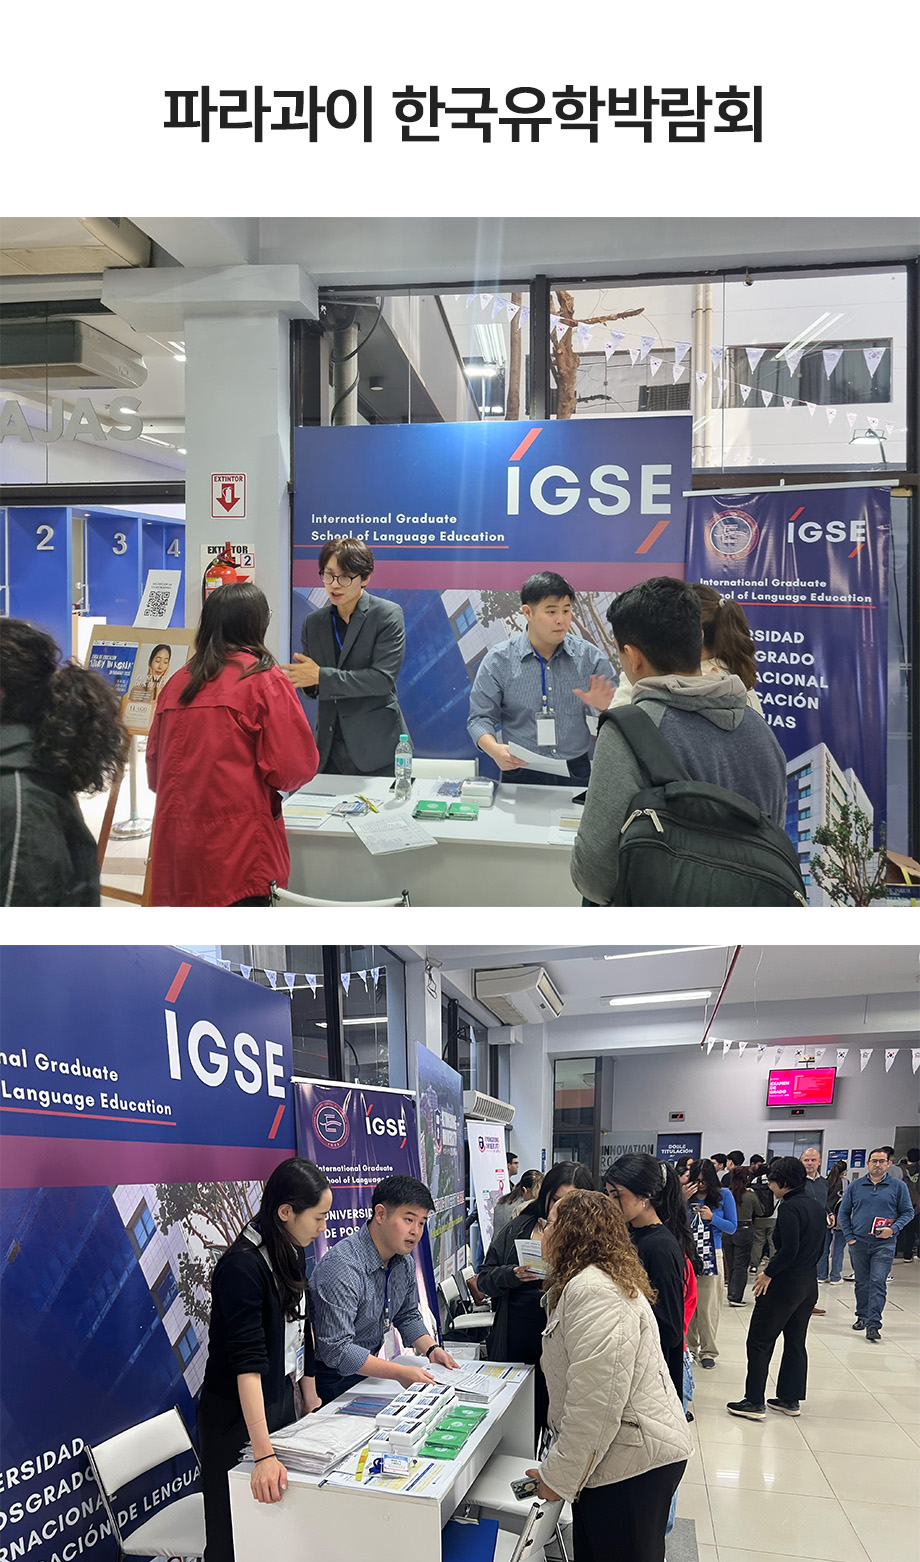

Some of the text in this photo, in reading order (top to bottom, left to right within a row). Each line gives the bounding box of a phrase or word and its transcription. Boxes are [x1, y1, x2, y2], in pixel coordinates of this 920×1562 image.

[213, 475, 244, 483] EXTINTOR
[507, 465, 673, 516] IGSE
[311, 513, 457, 525] International Graduate
[36, 524, 54, 551] 2
[311, 531, 505, 545] School of Language Education
[787, 520, 866, 544] IGSE
[112, 532, 128, 555] 3
[167, 538, 181, 558] 4
[207, 545, 249, 555] EXTITOR
[243, 555, 252, 567] 2
[700, 578, 827, 588] International Graduate
[738, 591, 749, 600] of
[752, 591, 807, 604] Language
[810, 592, 872, 603] Education
[165, 1009, 286, 1099] IGSE
[35, 1056, 119, 1082] Graduate
[1, 1080, 173, 1116] Language Education
[365, 1115, 407, 1137] IGSE
[601, 1144, 655, 1156] INNOVATION
[362, 1164, 394, 1173] Graduate
[325, 1228, 338, 1239] DE
[117, 1503, 139, 1529] DE
